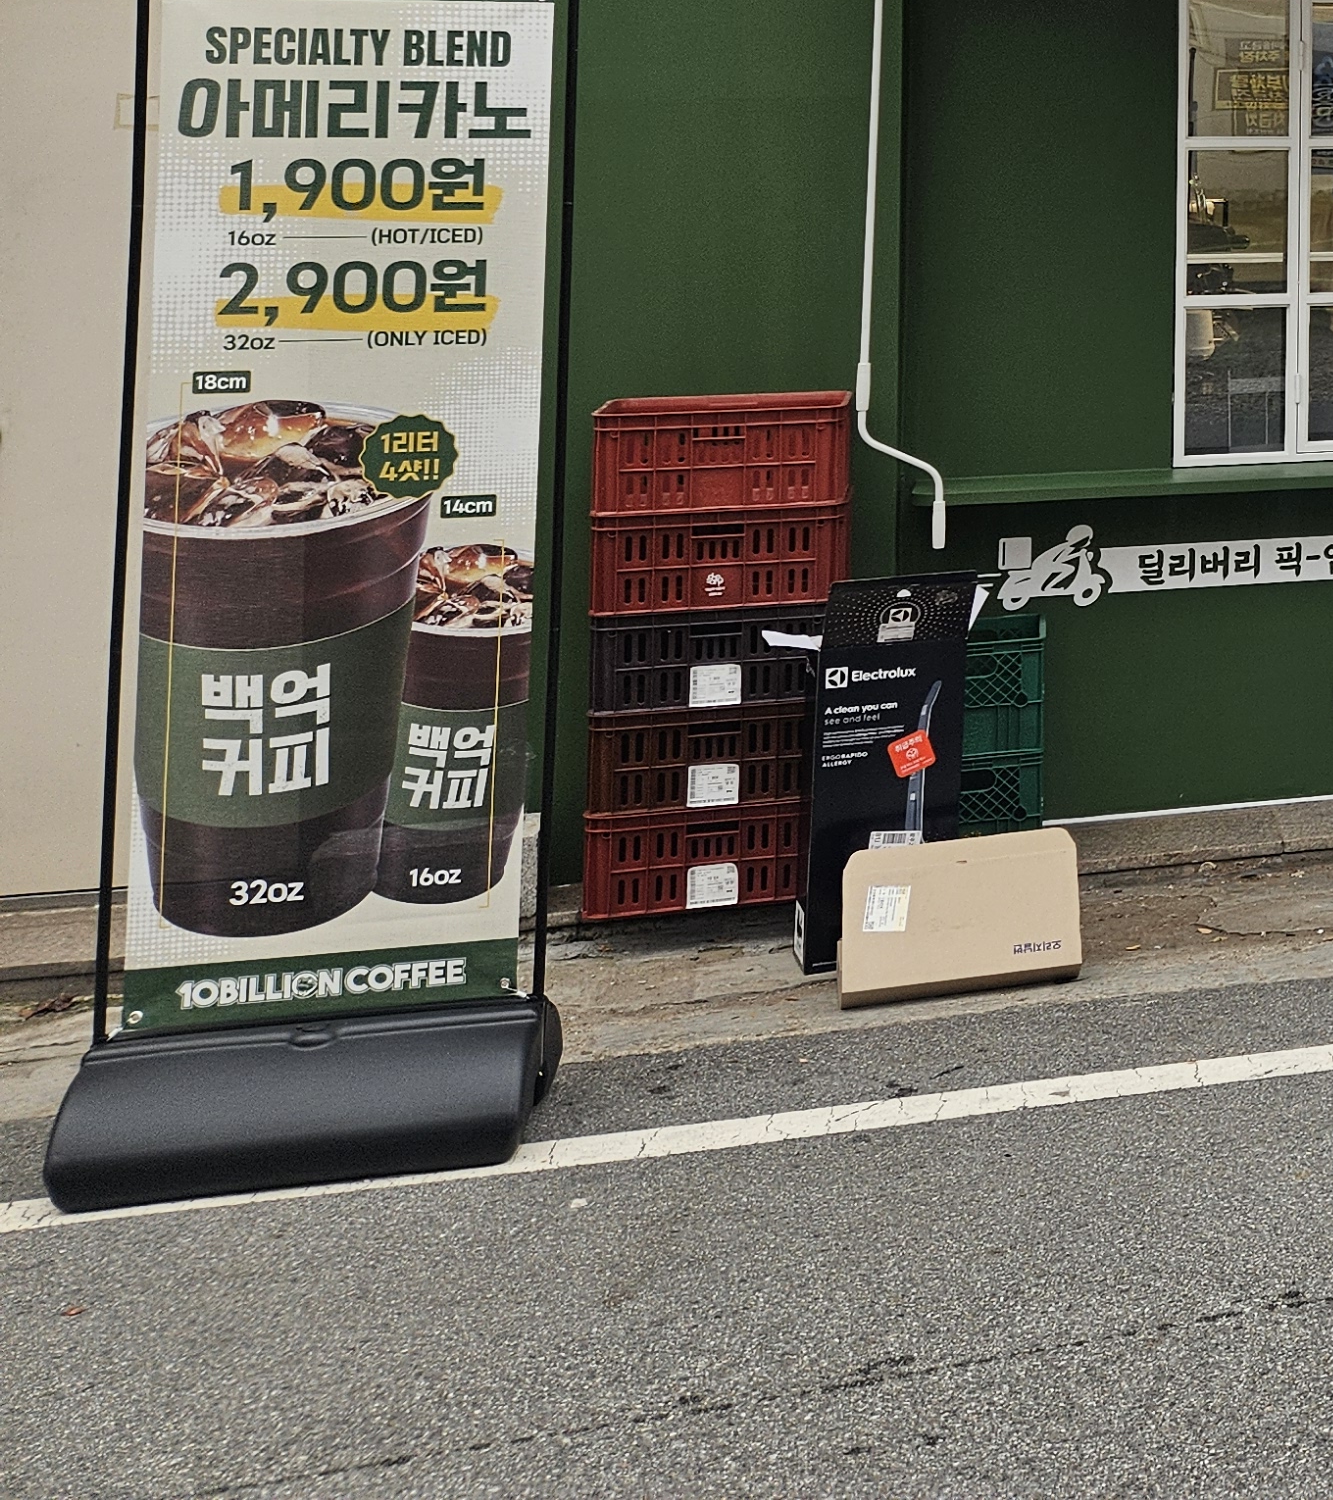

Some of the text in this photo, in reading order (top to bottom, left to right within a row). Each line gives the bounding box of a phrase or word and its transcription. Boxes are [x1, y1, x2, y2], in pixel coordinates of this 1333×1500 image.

[206, 27, 511, 68] SPECIALTY BLEND
[177, 78, 531, 139] 아메리카노
[230, 157, 485, 223] 1,900원
[228, 227, 483, 246] 16oz (HOT/ICED)
[217, 259, 488, 326] 2,900원
[223, 329, 487, 350] 32oz (ONLY ICED)
[195, 374, 248, 391] 18cm
[381, 431, 439, 454] 1리터
[380, 458, 440, 482] 4샷!!
[444, 498, 493, 514] 14cm
[1137, 541, 1262, 586] 딜리버리
[852, 667, 916, 682] Electrolux
[201, 663, 331, 735] 백억
[825, 702, 898, 715] A clean you can
[843, 715, 861, 723] and
[863, 713, 880, 721] feel
[408, 723, 495, 767] 백억
[201, 727, 330, 796] 커피
[402, 766, 487, 810] 커피
[409, 868, 462, 887] 16oz
[229, 880, 305, 906] 32oz
[176, 958, 467, 1009] 10BILLION COFFEE
